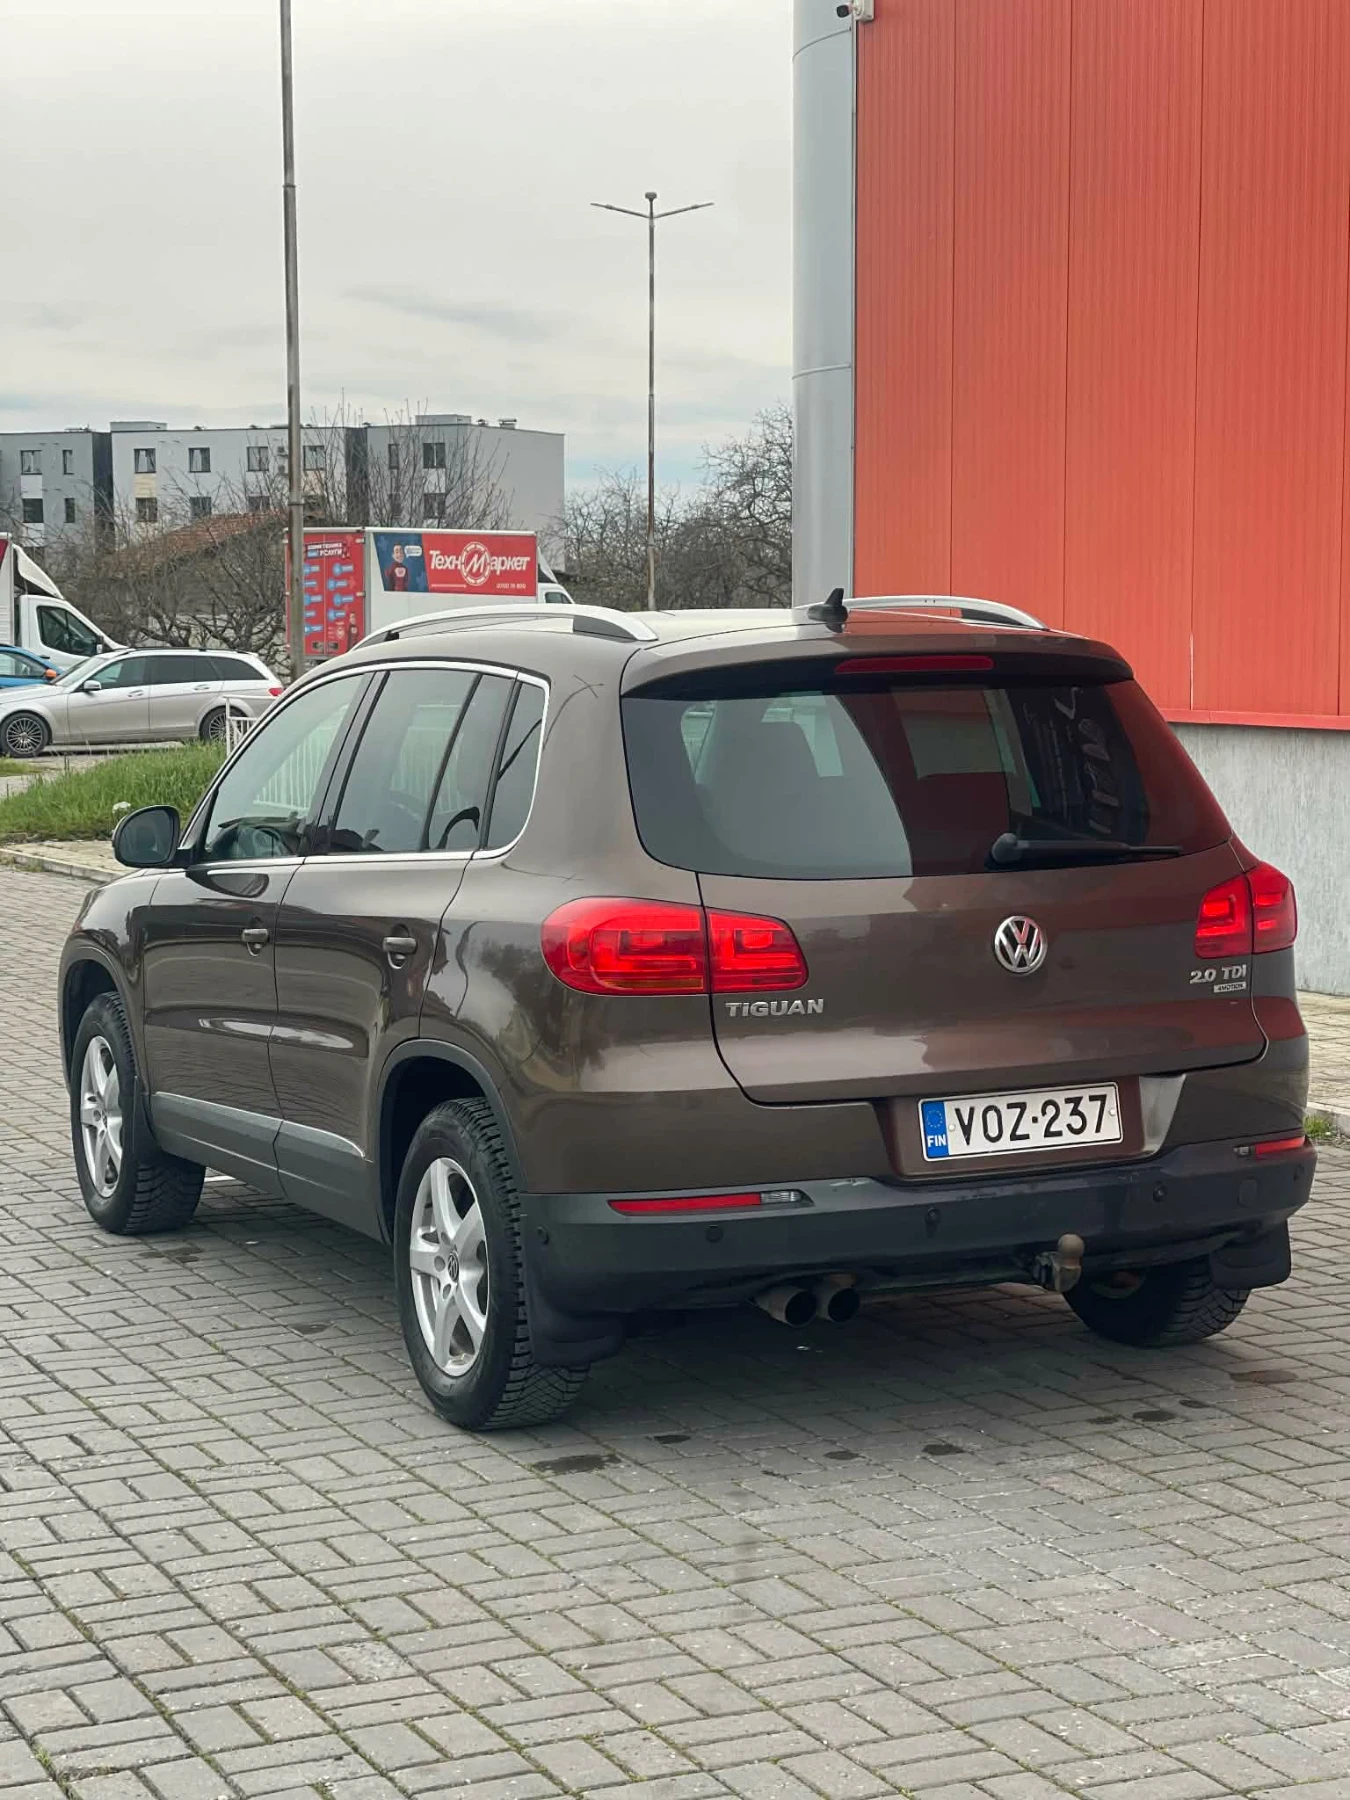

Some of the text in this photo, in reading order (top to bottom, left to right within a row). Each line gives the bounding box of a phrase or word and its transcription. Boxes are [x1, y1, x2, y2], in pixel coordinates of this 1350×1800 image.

[1222, 964, 1246, 979] TDI
[725, 998, 824, 1017] TIGUAN
[927, 1134, 947, 1147] FIN
